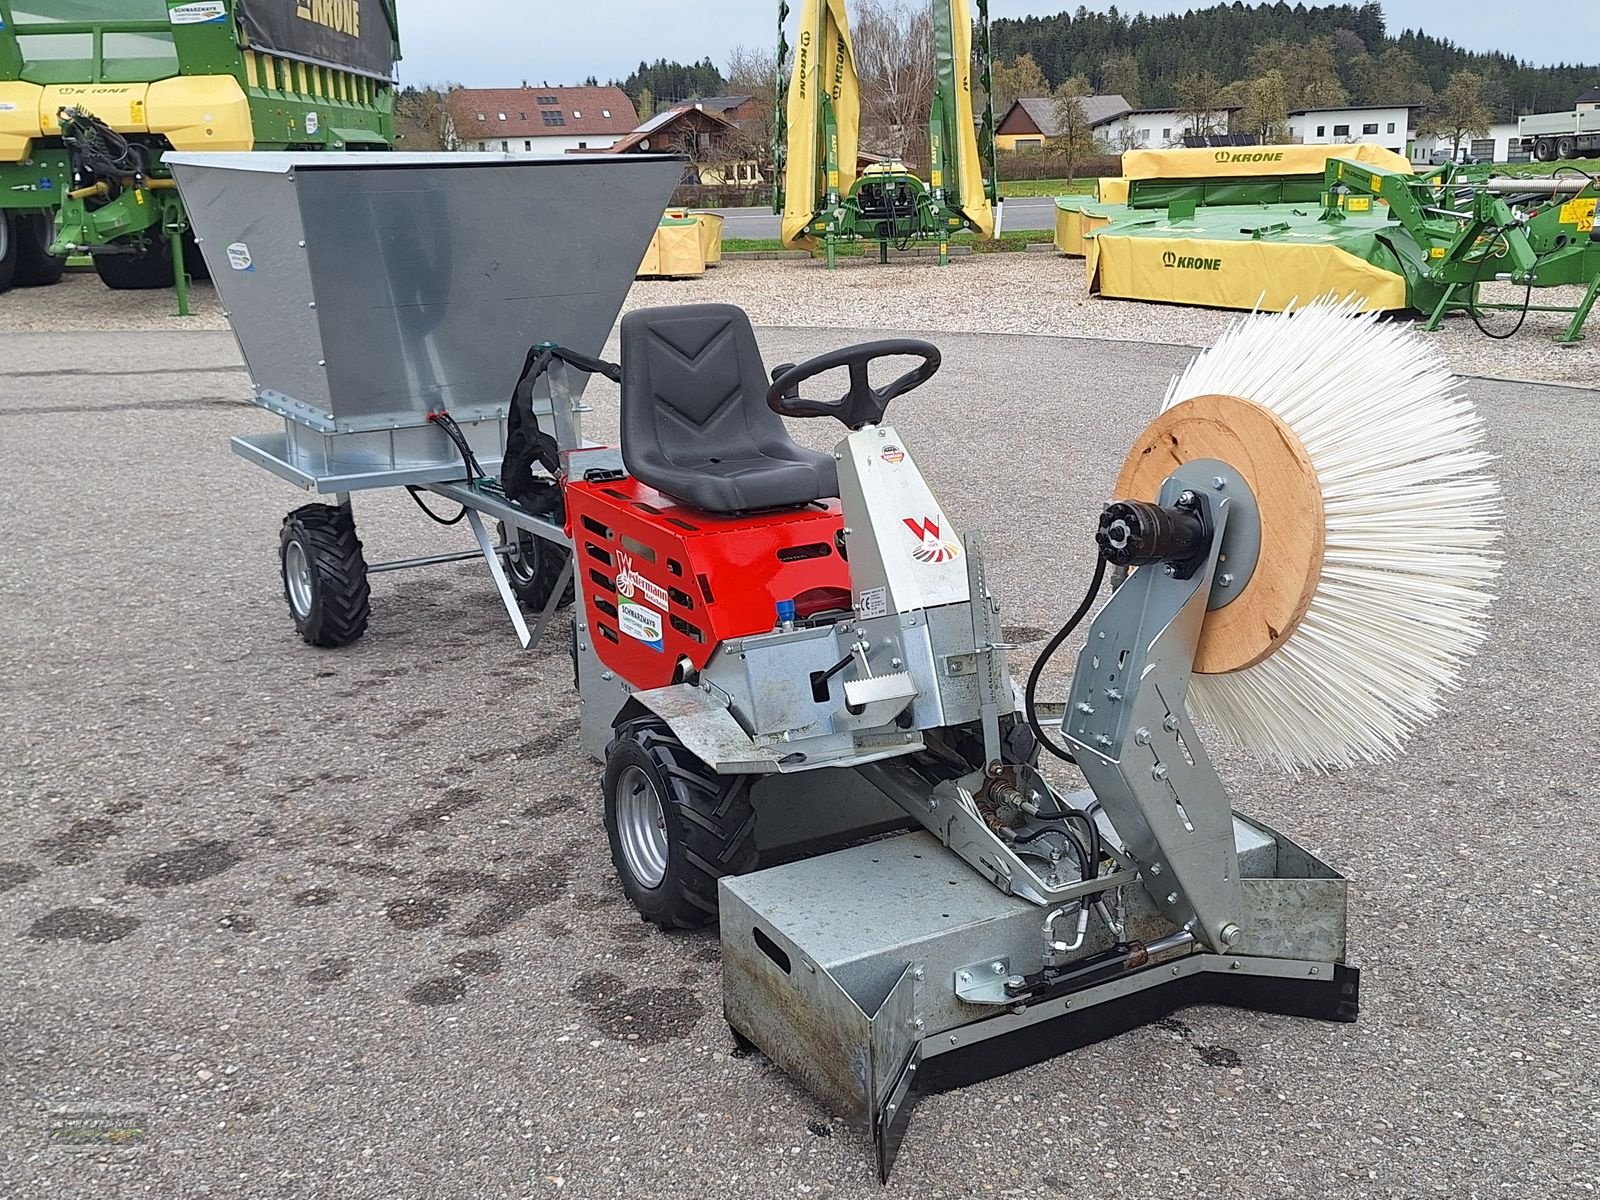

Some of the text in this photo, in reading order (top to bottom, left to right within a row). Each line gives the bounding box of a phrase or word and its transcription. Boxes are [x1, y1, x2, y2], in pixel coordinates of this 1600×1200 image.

[312, 0, 360, 38] KRONE
[1231, 153, 1284, 163] KRONE
[1177, 256, 1222, 271] KRONE
[621, 605, 656, 629] SCHWARZMAYR
